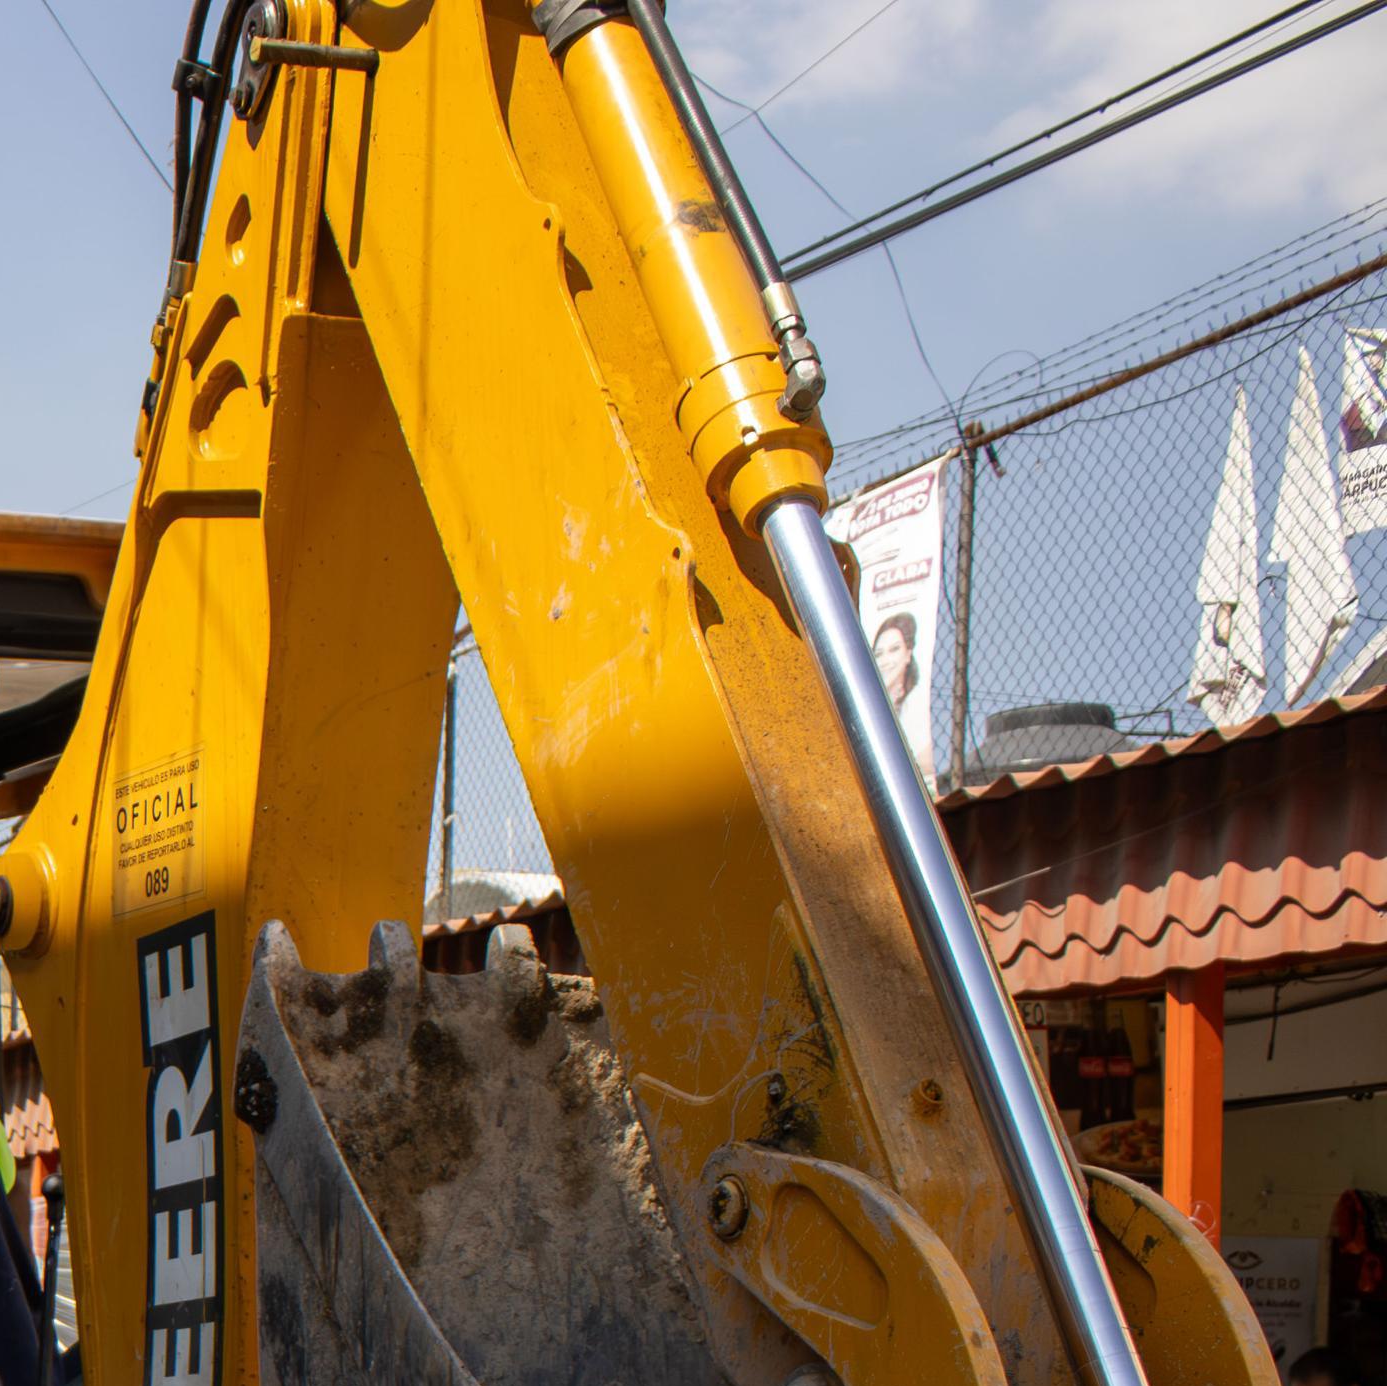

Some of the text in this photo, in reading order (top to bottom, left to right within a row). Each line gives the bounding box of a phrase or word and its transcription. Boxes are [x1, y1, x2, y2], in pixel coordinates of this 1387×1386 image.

[874, 560, 931, 588] CLARA
[115, 784, 130, 800] ESTE
[169, 765, 185, 780] PARA
[186, 759, 199, 773] USO
[116, 781, 199, 834] OFICIAL
[153, 829, 166, 844] USO
[166, 820, 194, 839] DISTINTO
[118, 856, 138, 870] FAVOR
[138, 852, 146, 864] DE
[145, 866, 170, 898] 089
